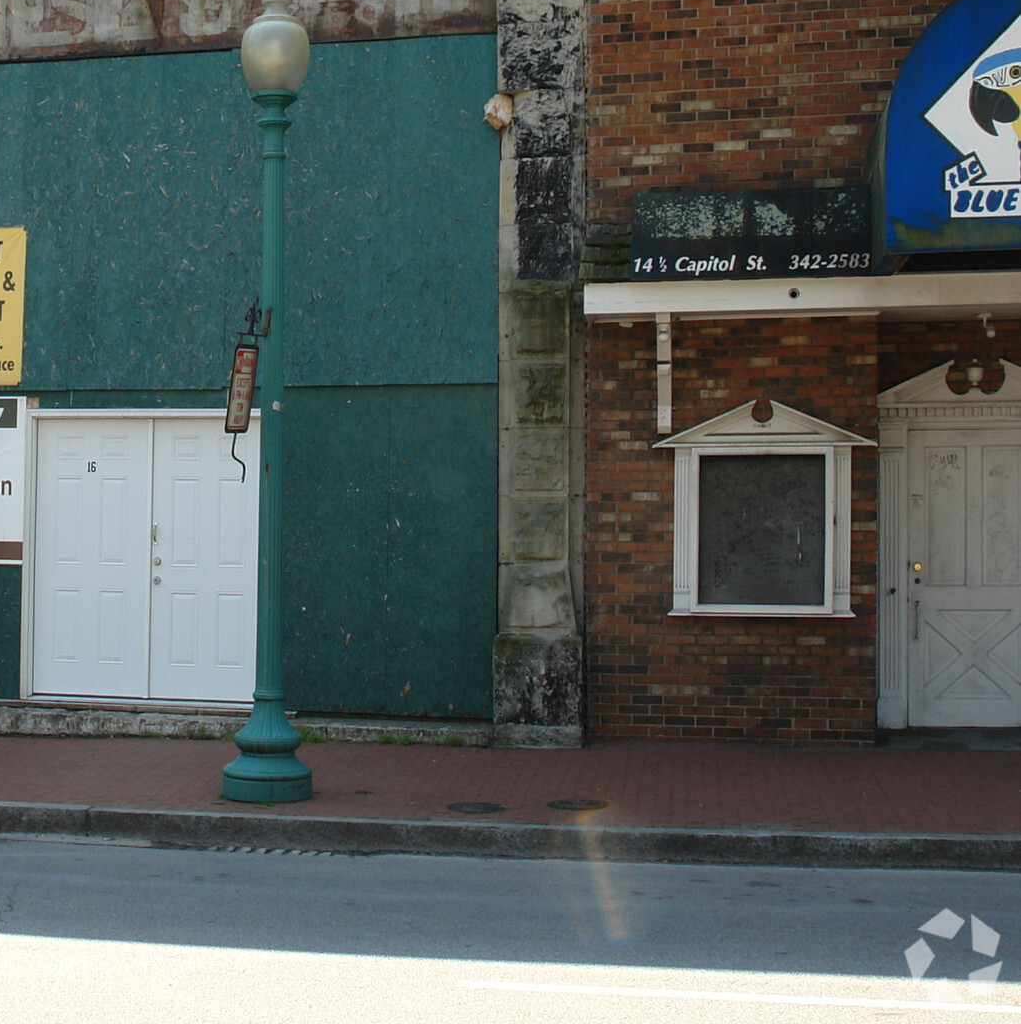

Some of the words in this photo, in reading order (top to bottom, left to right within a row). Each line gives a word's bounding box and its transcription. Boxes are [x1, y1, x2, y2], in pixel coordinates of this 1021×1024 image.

[948, 160, 980, 189] the
[954, 188, 1020, 213] BLUE
[633, 257, 653, 273] 14
[675, 255, 736, 276] Capitol
[746, 255, 767, 271] St.
[789, 253, 870, 270] 342-2583
[2, 271, 16, 292] &
[87, 461, 97, 473] 16
